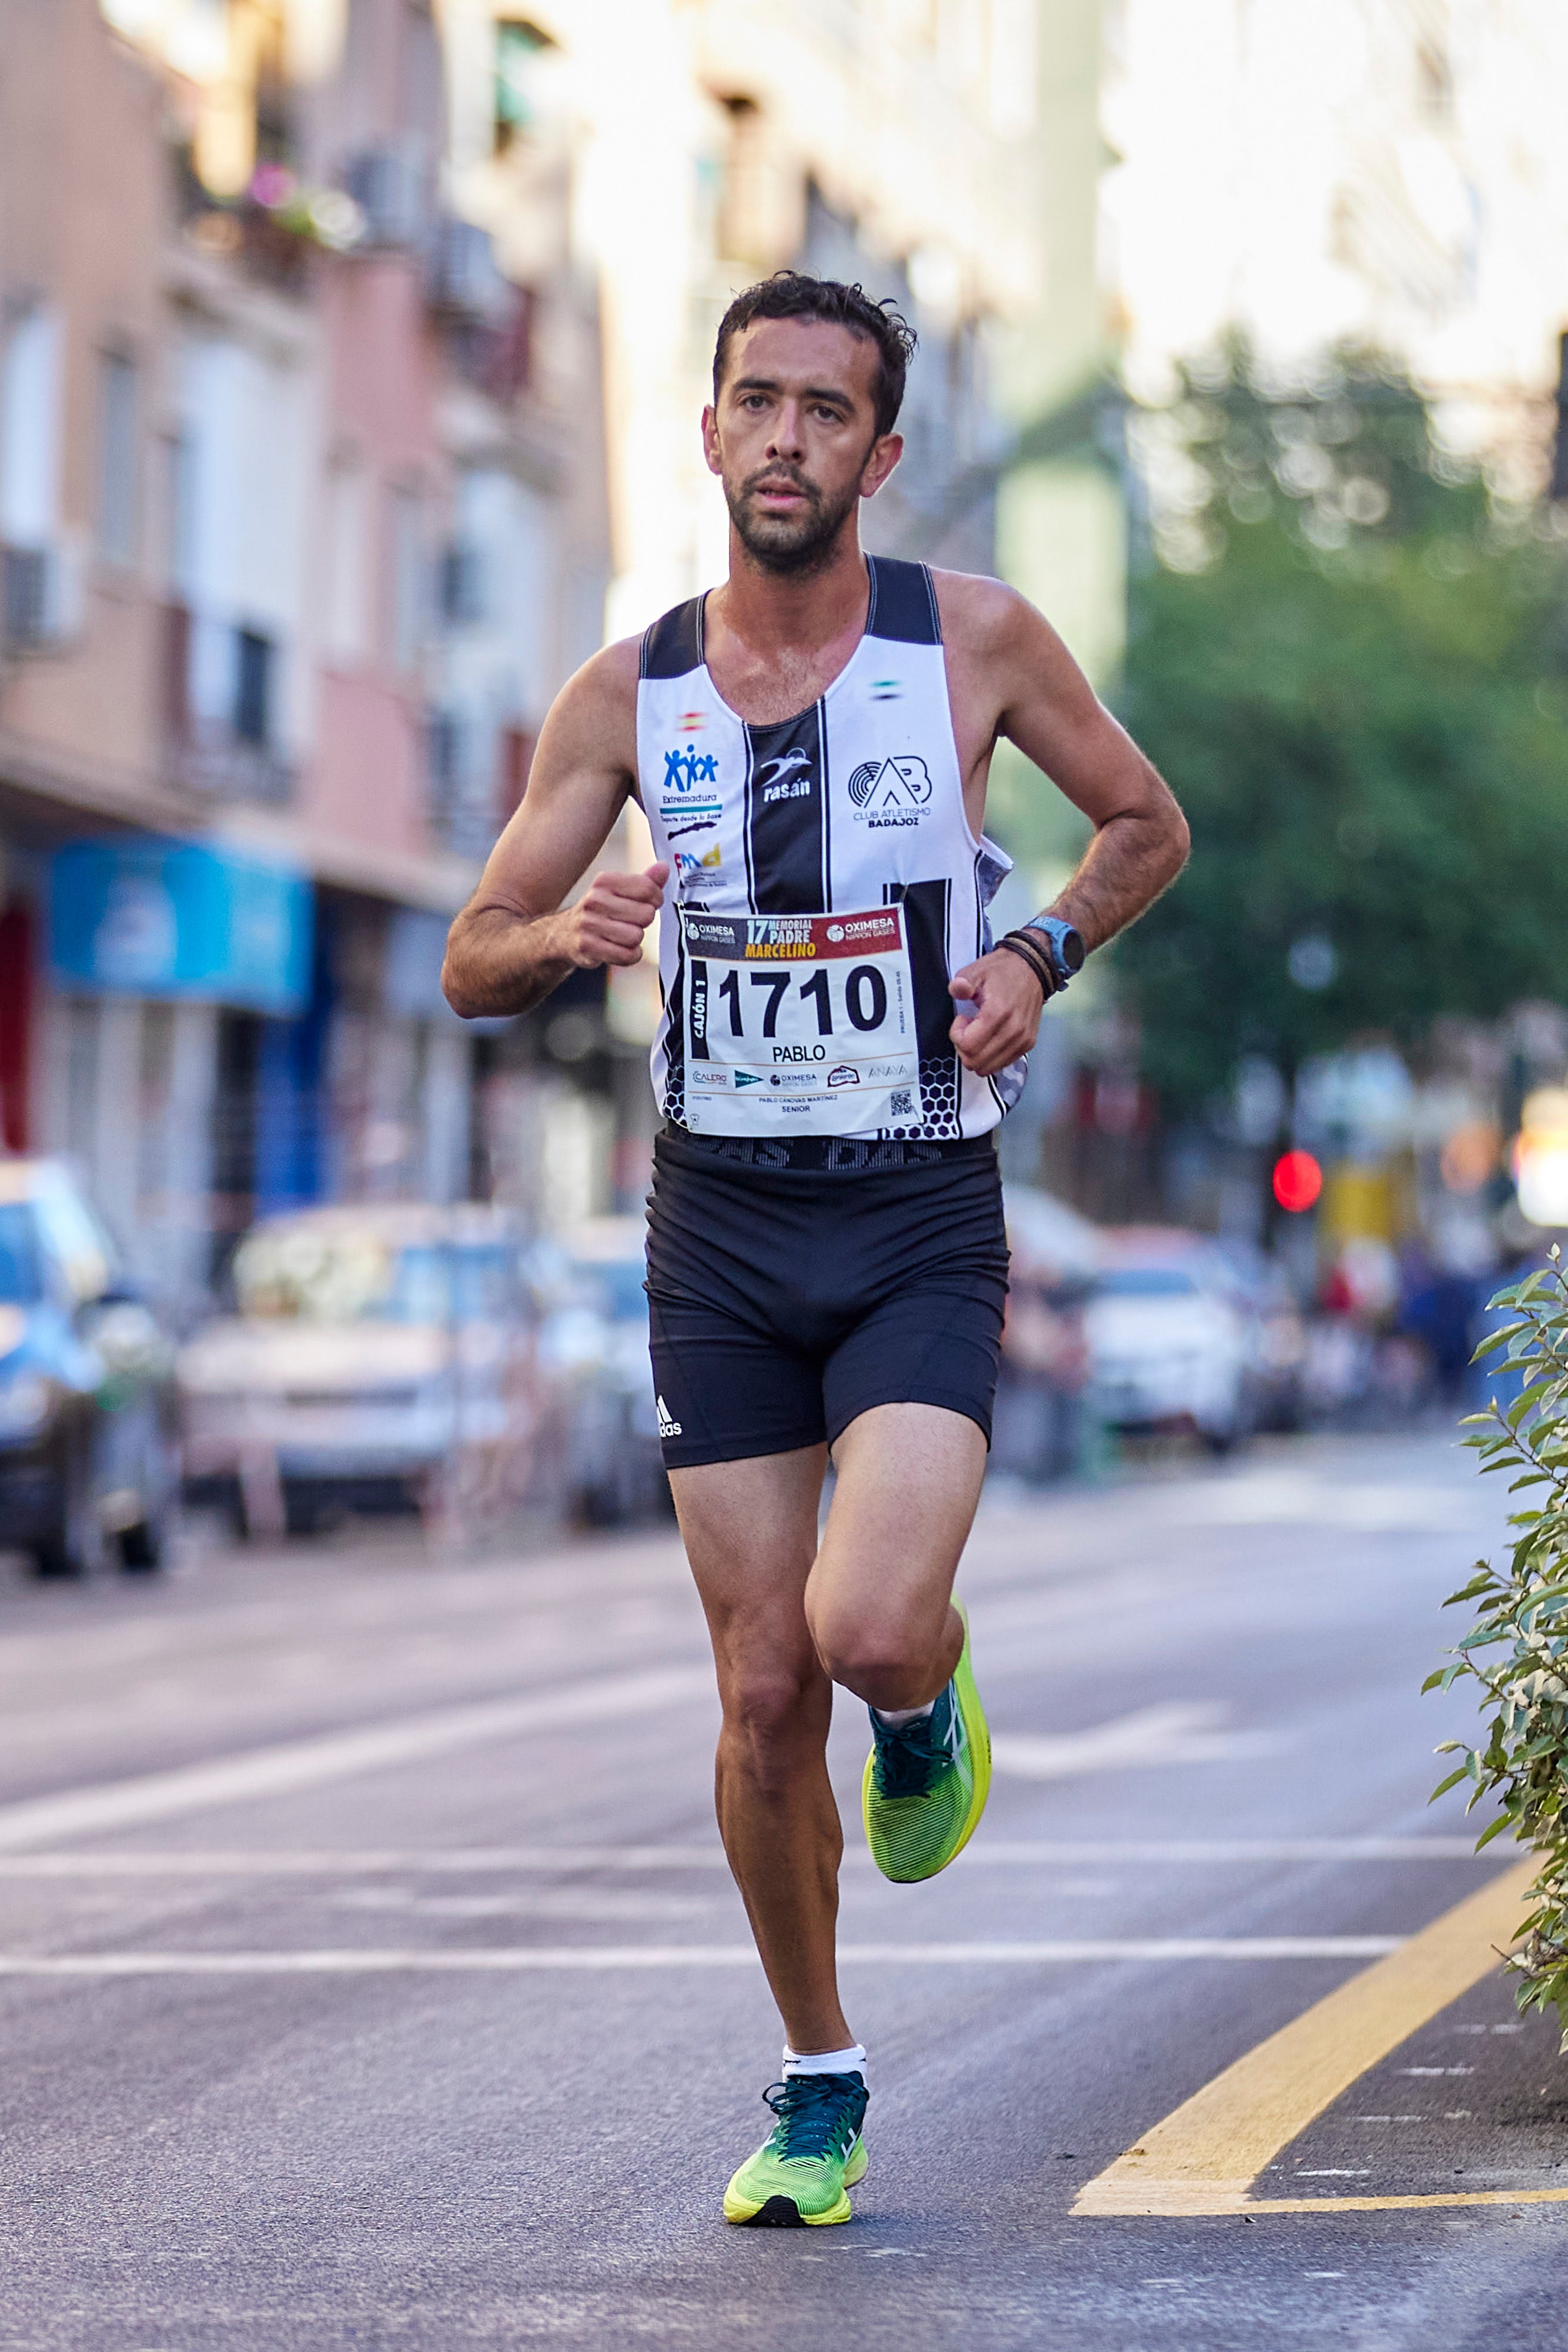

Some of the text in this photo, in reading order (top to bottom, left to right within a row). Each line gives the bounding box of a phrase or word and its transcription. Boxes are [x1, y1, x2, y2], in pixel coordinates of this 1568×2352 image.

[764, 777, 810, 802] rasán
[663, 794, 717, 803] Extremadura
[854, 807, 931, 820] CLUB ATLETISMO
[868, 817, 919, 828] BADAJOZ
[698, 924, 734, 936] OXIMESA
[768, 919, 813, 930] MEMORIAL
[845, 917, 894, 933] OXIMESA
[747, 920, 768, 944] 17
[770, 930, 810, 944] PADRE
[873, 927, 895, 937] GASES
[745, 943, 816, 957] MARCELINO
[719, 964, 887, 1038] 1710
[692, 993, 705, 1038] CAJÓN
[773, 1045, 825, 1062] PABLO
[696, 1073, 727, 1082] CALERO
[868, 1065, 908, 1078] ANAYA
